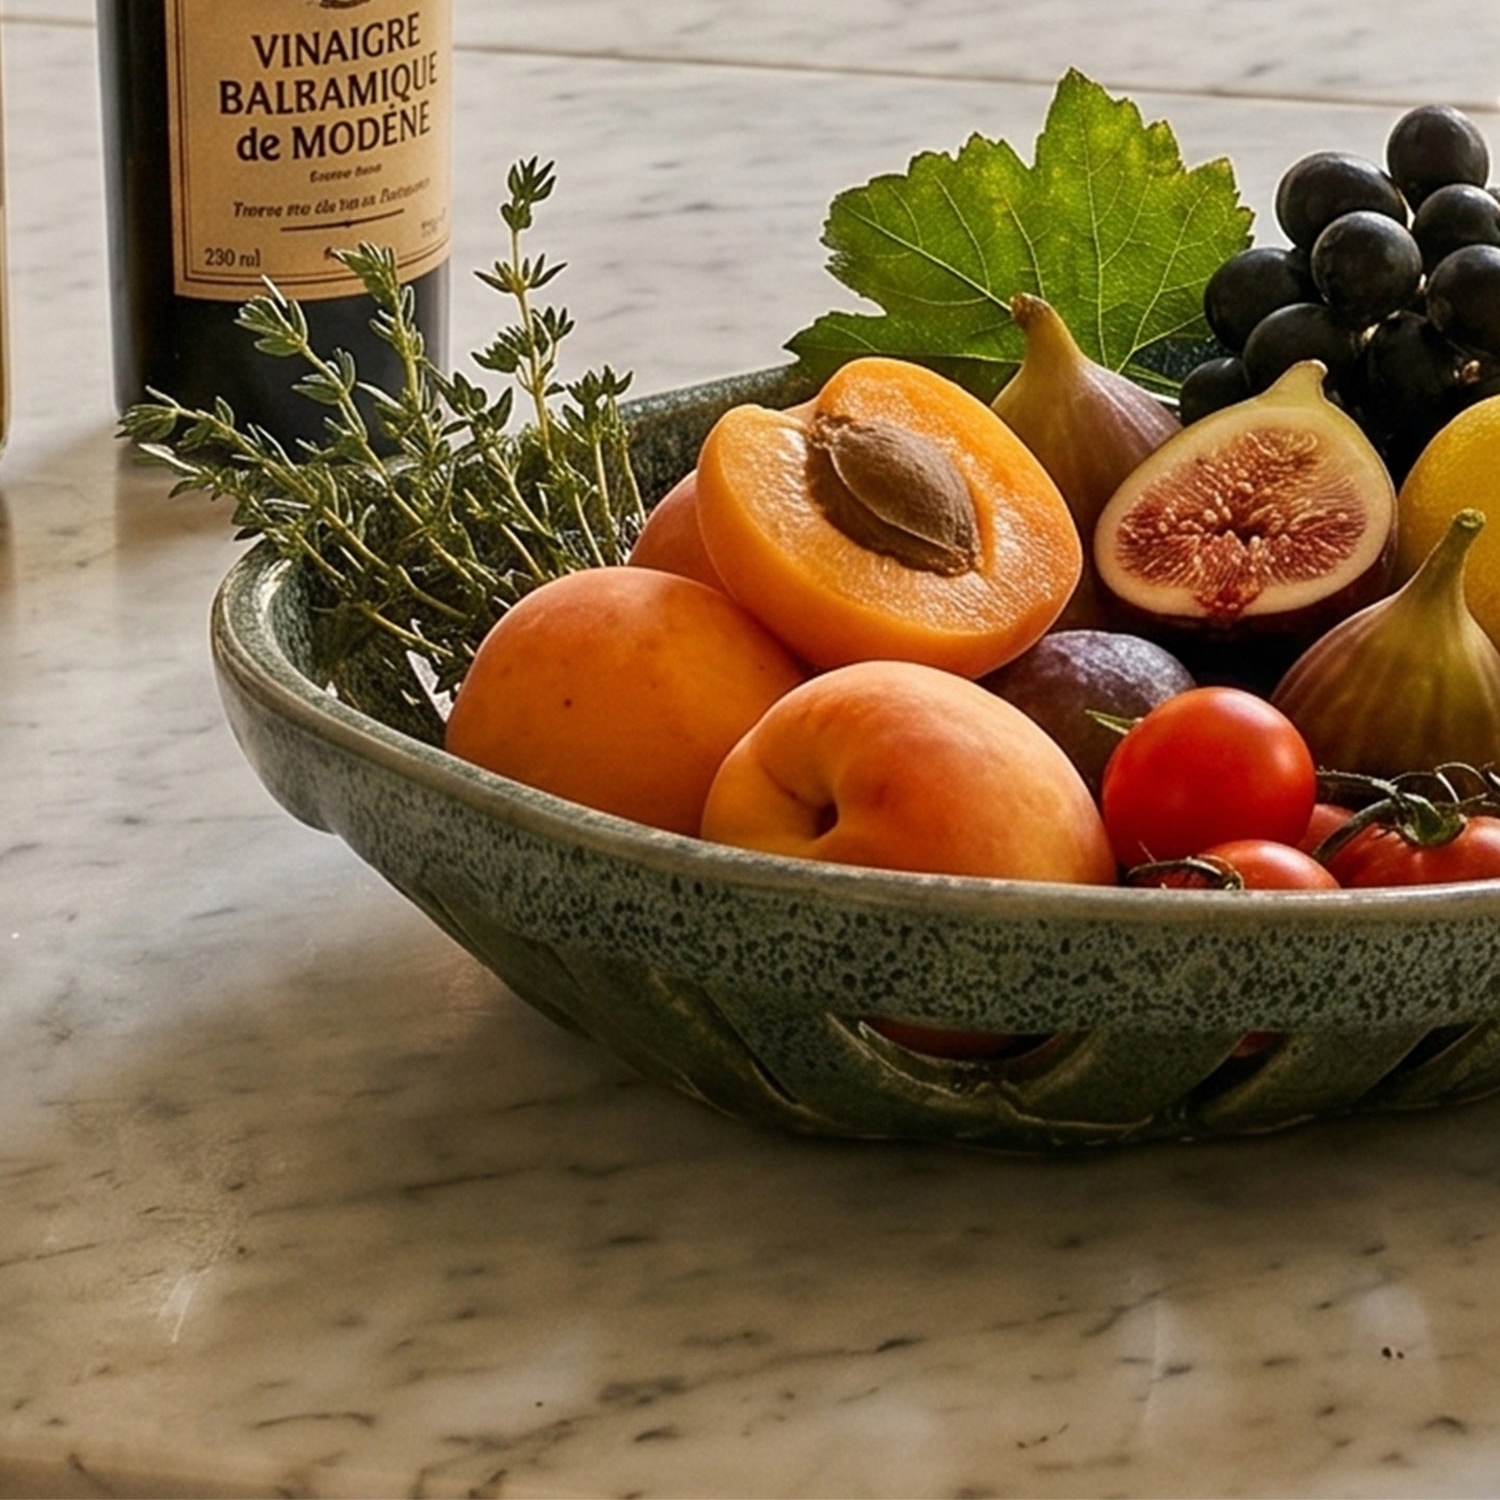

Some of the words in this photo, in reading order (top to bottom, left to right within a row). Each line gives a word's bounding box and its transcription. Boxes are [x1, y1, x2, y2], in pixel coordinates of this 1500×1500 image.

[251, 12, 421, 69] VINAIGRE
[236, 126, 281, 162] de
[204, 247, 236, 267] 230
